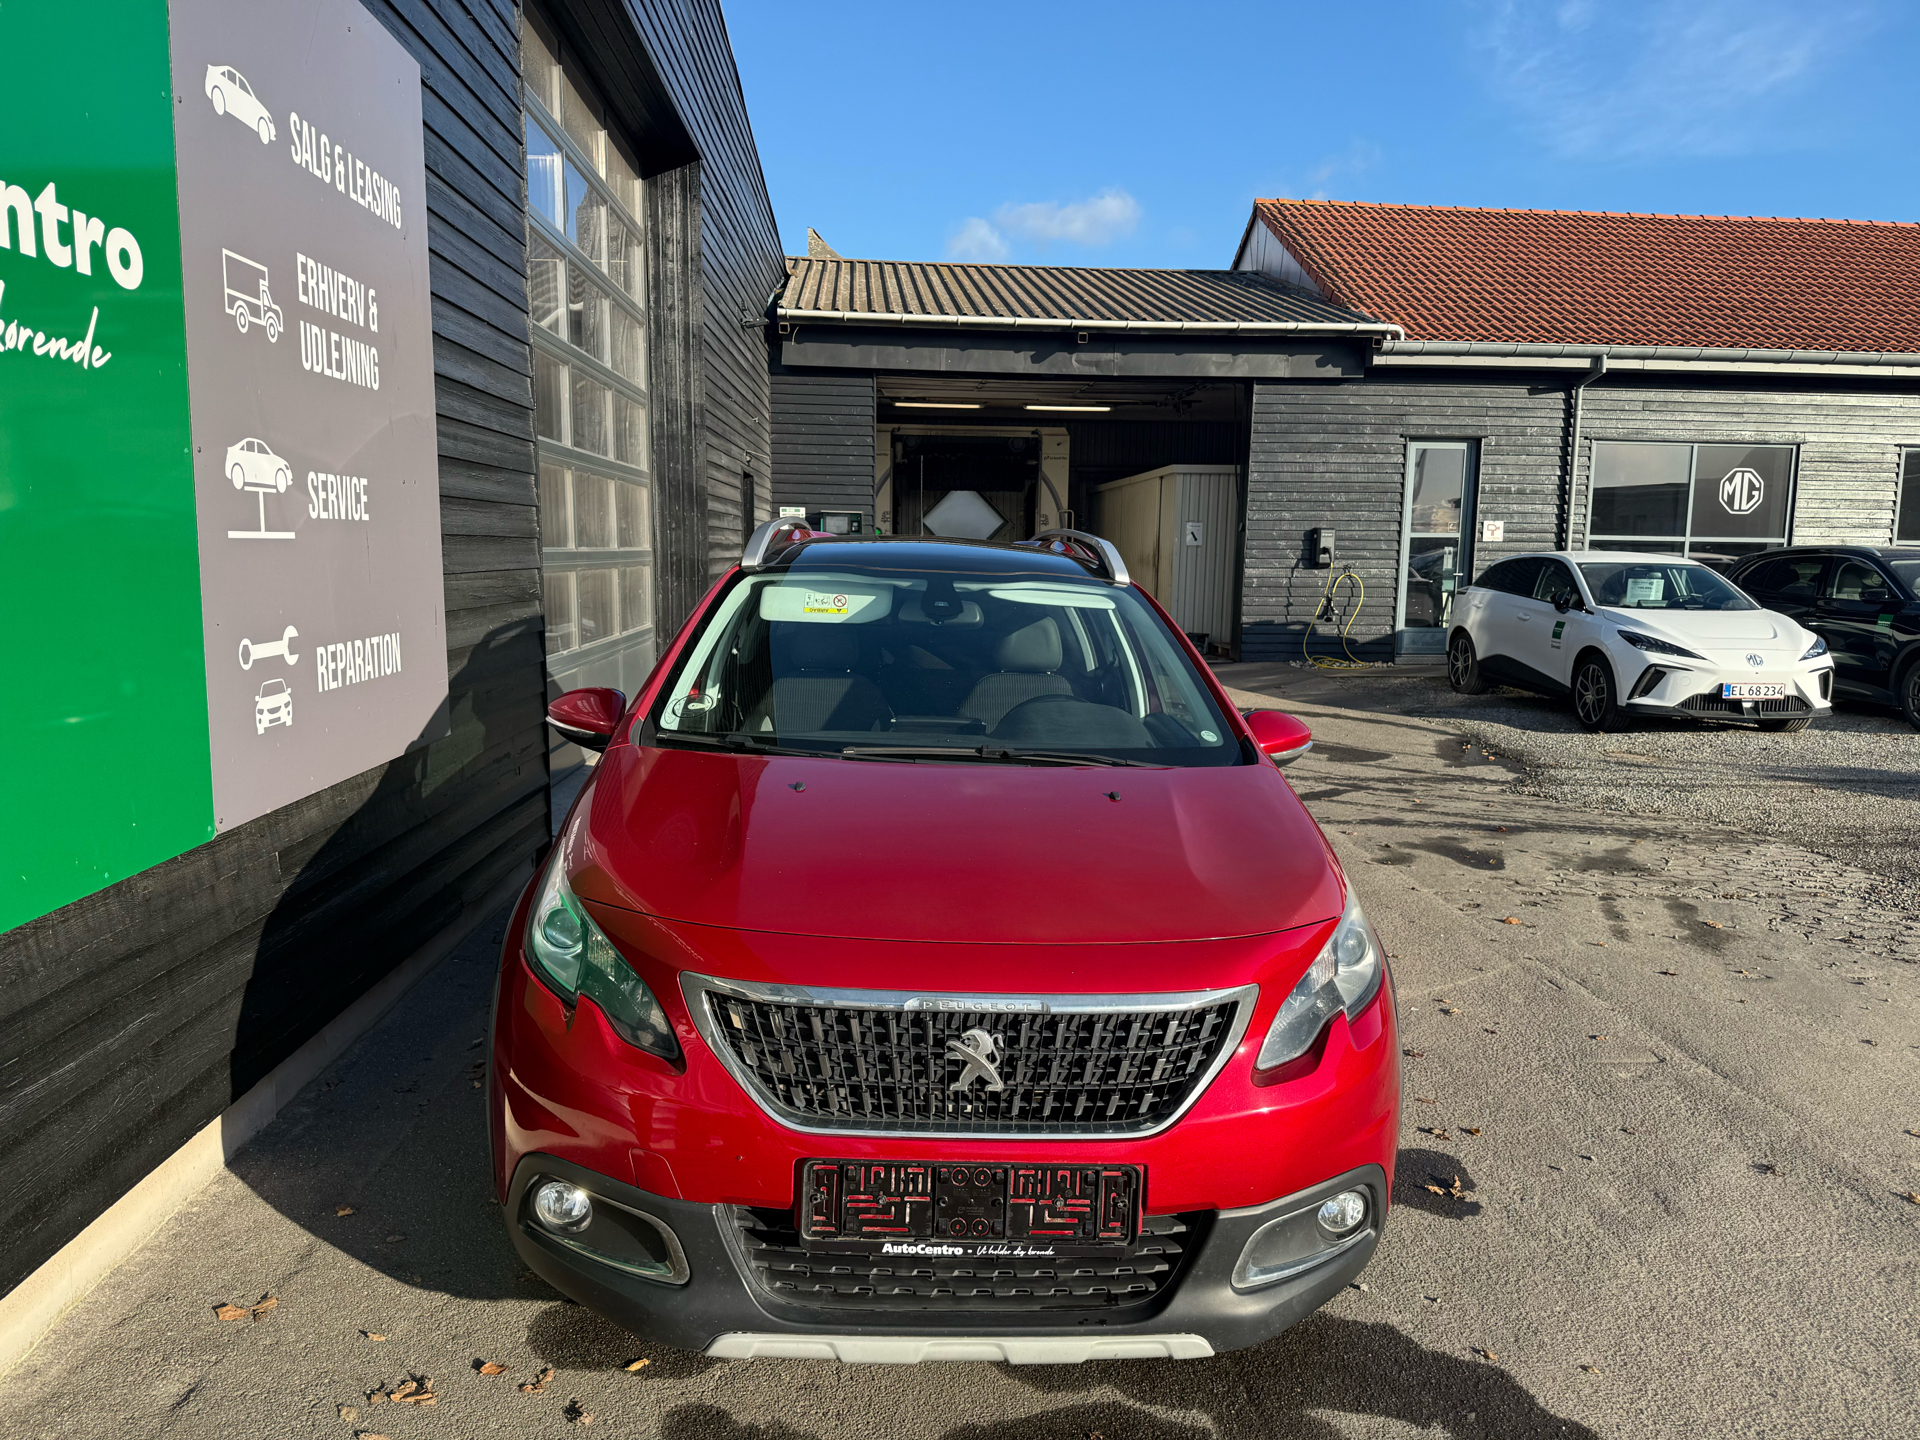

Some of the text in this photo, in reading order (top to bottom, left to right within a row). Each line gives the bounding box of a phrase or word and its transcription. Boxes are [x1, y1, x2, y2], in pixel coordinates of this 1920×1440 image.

[290, 111, 401, 229] SALG & LEASING
[0, 179, 144, 290] ntro
[296, 252, 378, 333] ERHVERV &
[300, 320, 379, 391] UDLEJNING
[308, 471, 369, 521] SERVICE
[1722, 471, 1761, 511] MG
[316, 632, 402, 693] REPARATION
[1747, 654, 1762, 666] MG
[1731, 686, 1745, 696] EL
[1748, 686, 1762, 696] 68
[1763, 686, 1783, 696] 234
[922, 1001, 1032, 1012] PEUGEOT
[882, 1243, 964, 1256] AutoCentro
[1012, 1245, 1027, 1257] dig
